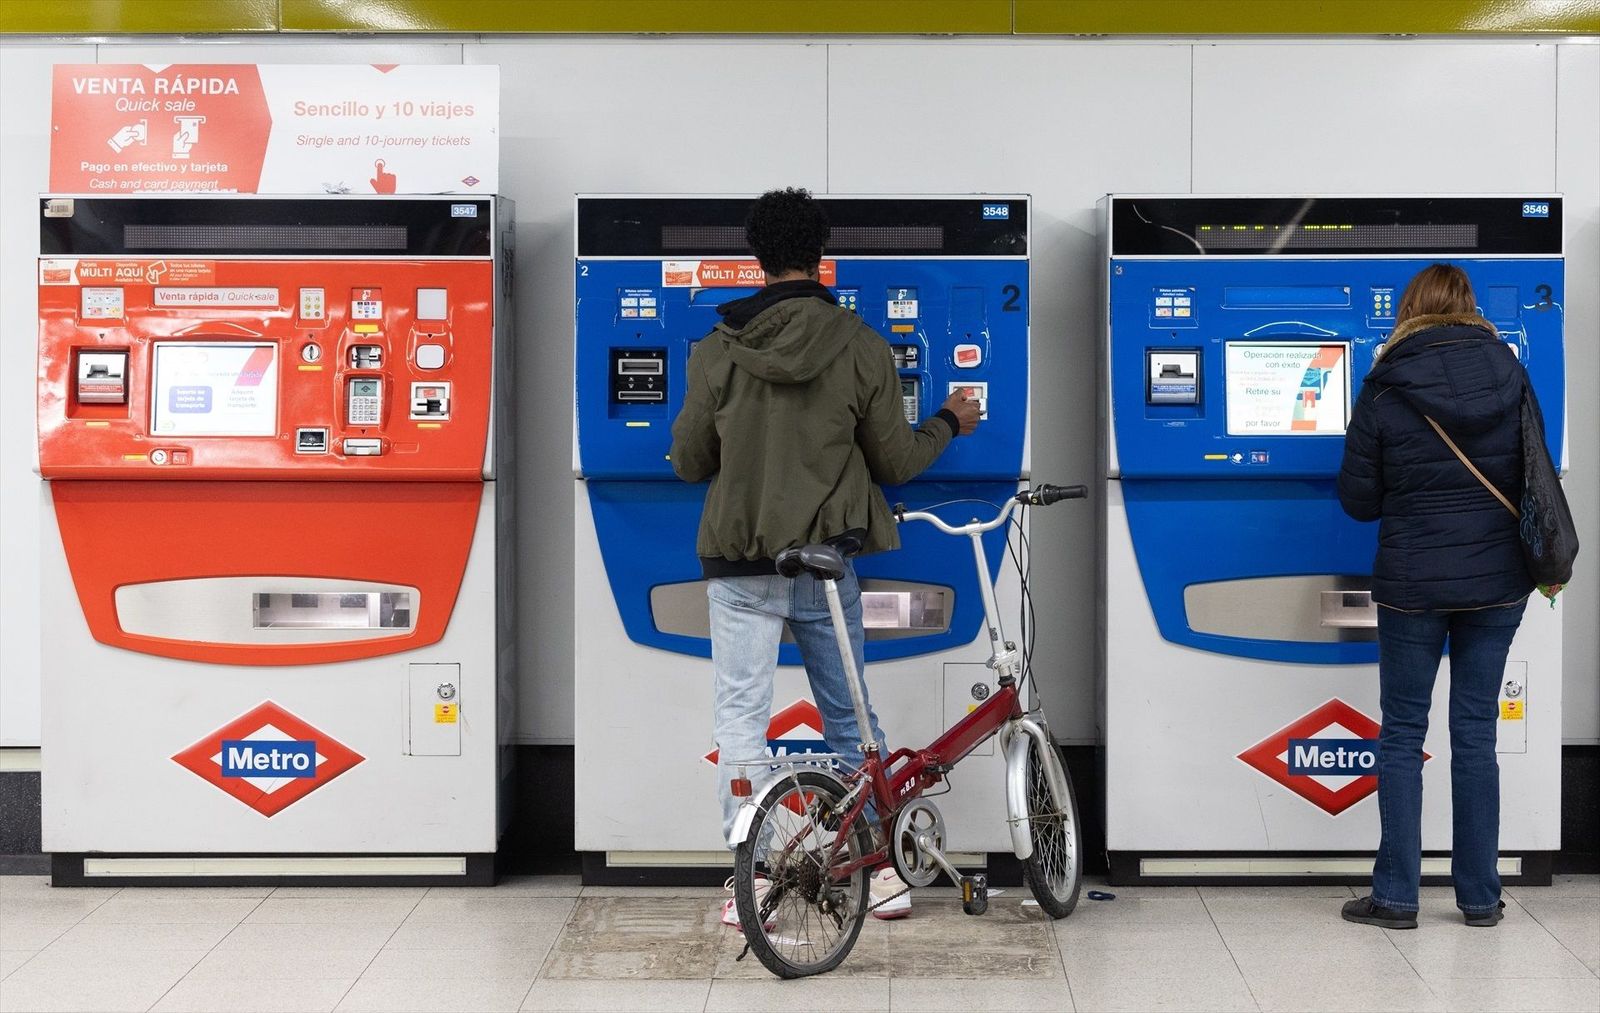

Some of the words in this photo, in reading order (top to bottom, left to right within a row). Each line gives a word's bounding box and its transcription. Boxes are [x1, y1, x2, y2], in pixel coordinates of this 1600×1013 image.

[72, 77, 146, 95] VENTA
[154, 74, 240, 95] RÁPIDA
[115, 97, 160, 112] Quick
[164, 97, 196, 112] sale
[293, 101, 369, 117] Sencillo
[375, 104, 386, 119] y
[393, 101, 414, 117] 10
[420, 101, 475, 119] viajes
[296, 135, 334, 147] Single
[337, 135, 360, 146] and
[365, 135, 428, 148] 10-journey
[431, 135, 471, 146] tickets
[80, 161, 110, 173] Pago
[113, 163, 128, 172] en
[131, 161, 177, 172] efectivo
[180, 163, 187, 173] y
[190, 161, 228, 173] tarjeta
[89, 178, 117, 189] Cash
[120, 178, 141, 189] and
[143, 178, 169, 189] card
[170, 178, 219, 191] payment
[453, 206, 475, 215] 3547
[983, 206, 1009, 216] 3548
[1523, 204, 1549, 214] 3549
[80, 268, 112, 277] MULTI
[581, 265, 589, 276] 2
[702, 270, 734, 279] MULTI
[1115, 265, 1123, 275] 3
[159, 291, 186, 301] Venta
[189, 290, 219, 303] rápida
[227, 291, 254, 302] Quick
[256, 291, 275, 301] sale
[1002, 285, 1021, 312] 2
[1535, 284, 1552, 312] 3
[1286, 350, 1321, 359] realizada
[1265, 361, 1280, 369] con
[1245, 420, 1259, 428] por
[1260, 419, 1281, 427] favor
[227, 747, 310, 771] Metro
[1293, 745, 1376, 769] Metro
